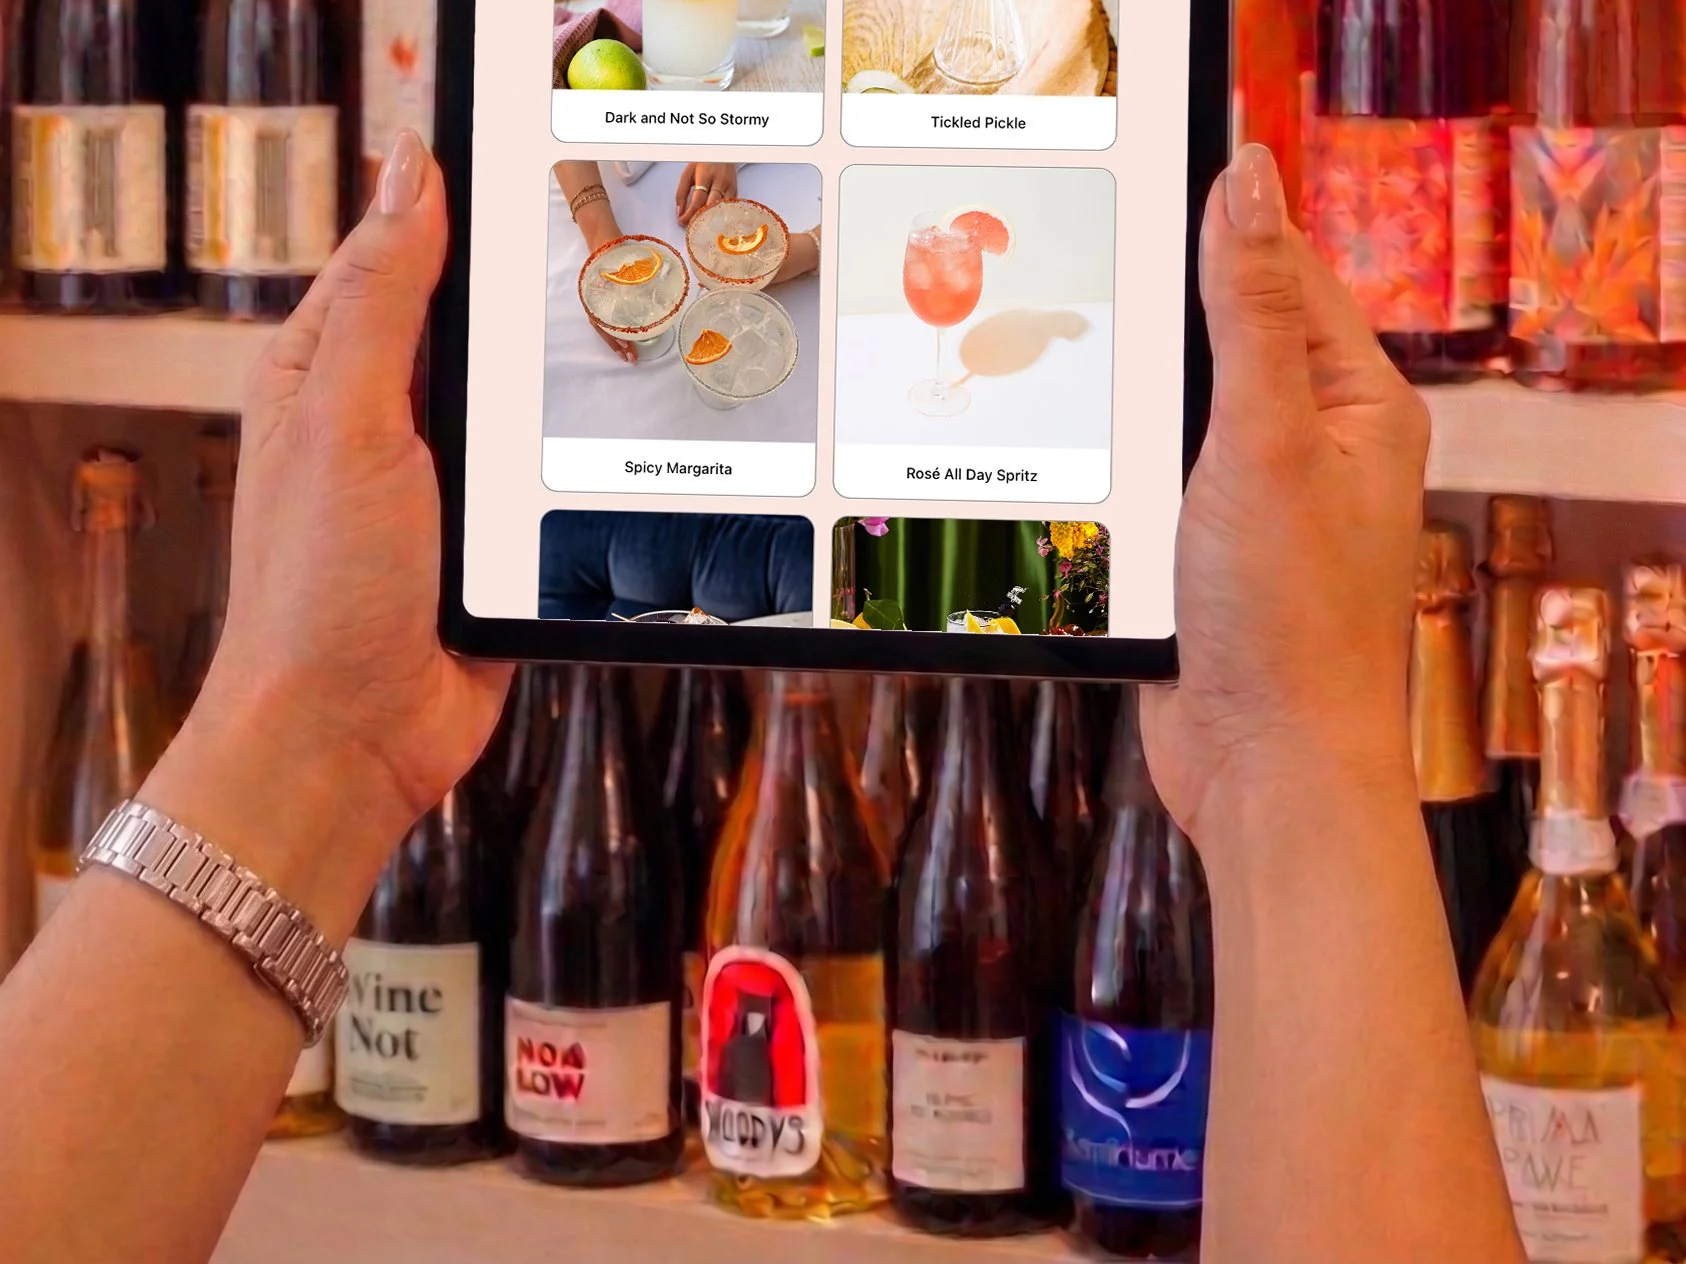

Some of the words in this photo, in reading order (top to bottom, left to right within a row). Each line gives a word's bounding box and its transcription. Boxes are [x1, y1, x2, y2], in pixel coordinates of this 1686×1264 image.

[605, 111, 637, 124] Dark
[640, 111, 666, 124] and
[670, 112, 695, 125] Not
[698, 112, 717, 125] So
[720, 112, 770, 129] Stormy
[930, 115, 981, 129] Tickled
[985, 116, 1026, 130] Pickle
[624, 460, 663, 477] Spicy
[666, 461, 733, 478] Margarita
[906, 466, 941, 480] Rosé
[944, 467, 962, 480] All
[966, 468, 993, 484] Day
[996, 468, 1038, 484] Spritz
[350, 1013, 421, 1062] Not
[516, 1067, 587, 1100] LOW
